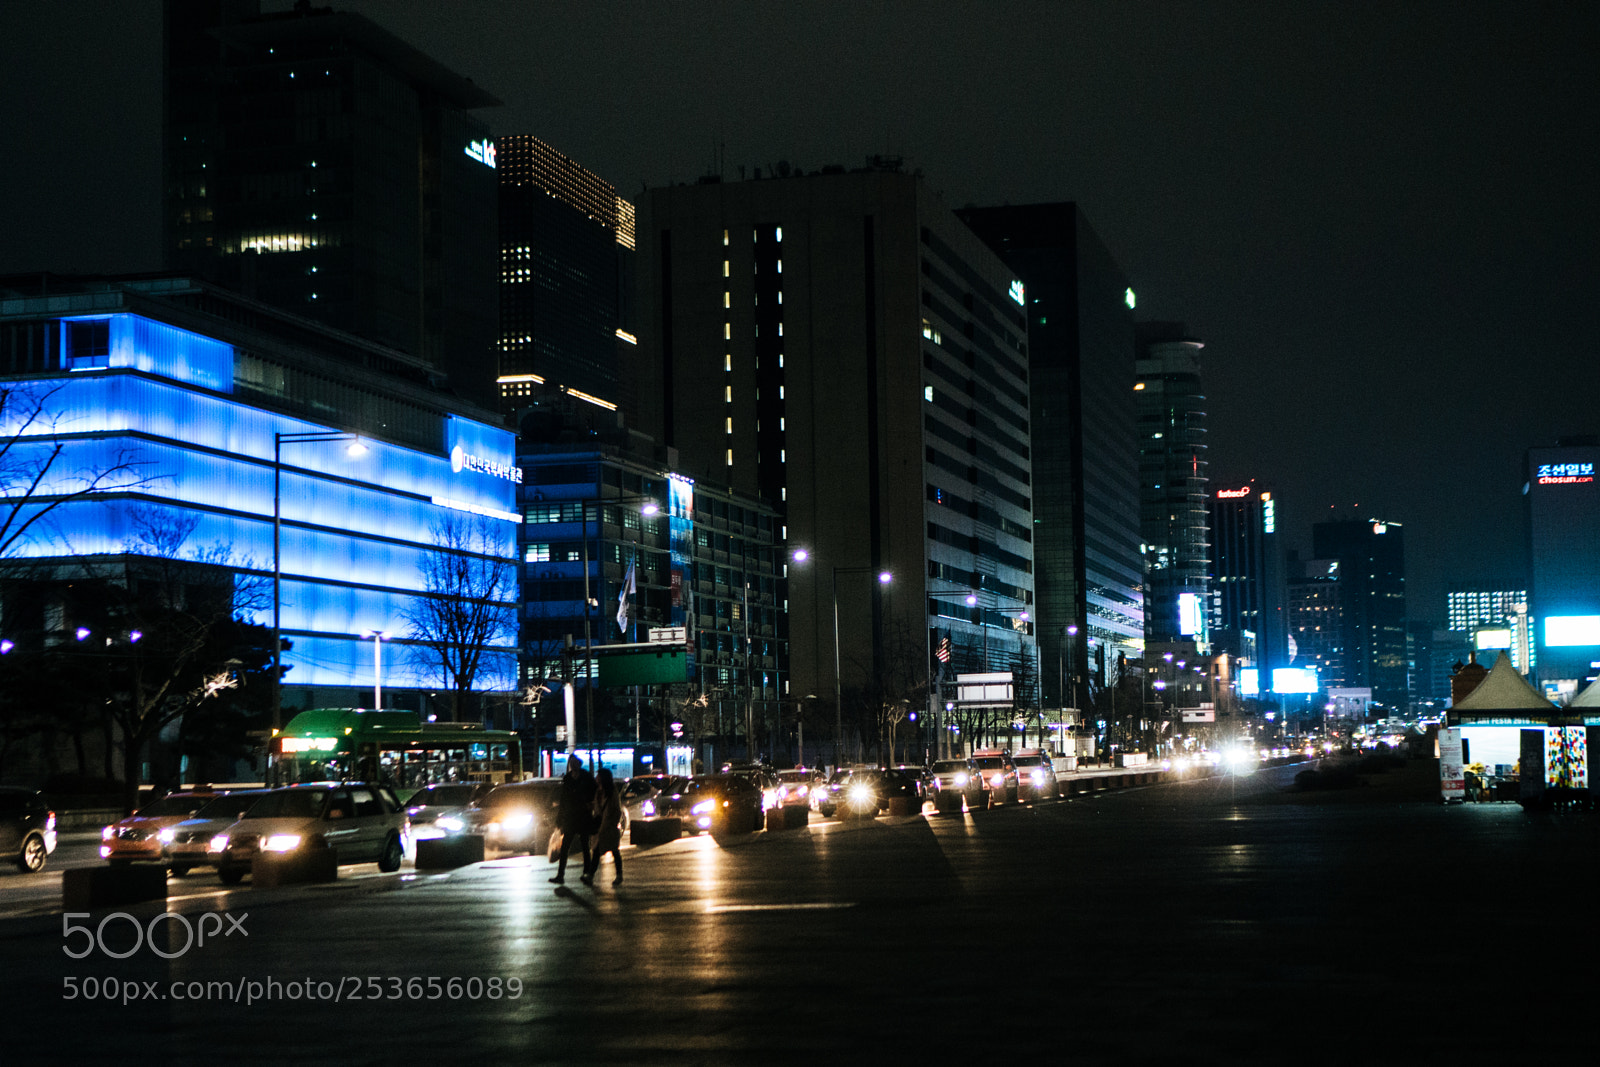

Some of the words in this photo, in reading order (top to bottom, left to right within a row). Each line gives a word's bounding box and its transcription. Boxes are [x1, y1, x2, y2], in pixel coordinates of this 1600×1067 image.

[463, 453, 523, 484] 대한민국역사박물관
[1536, 463, 1596, 477] 조선일보
[1538, 476, 1594, 485] chosun.com
